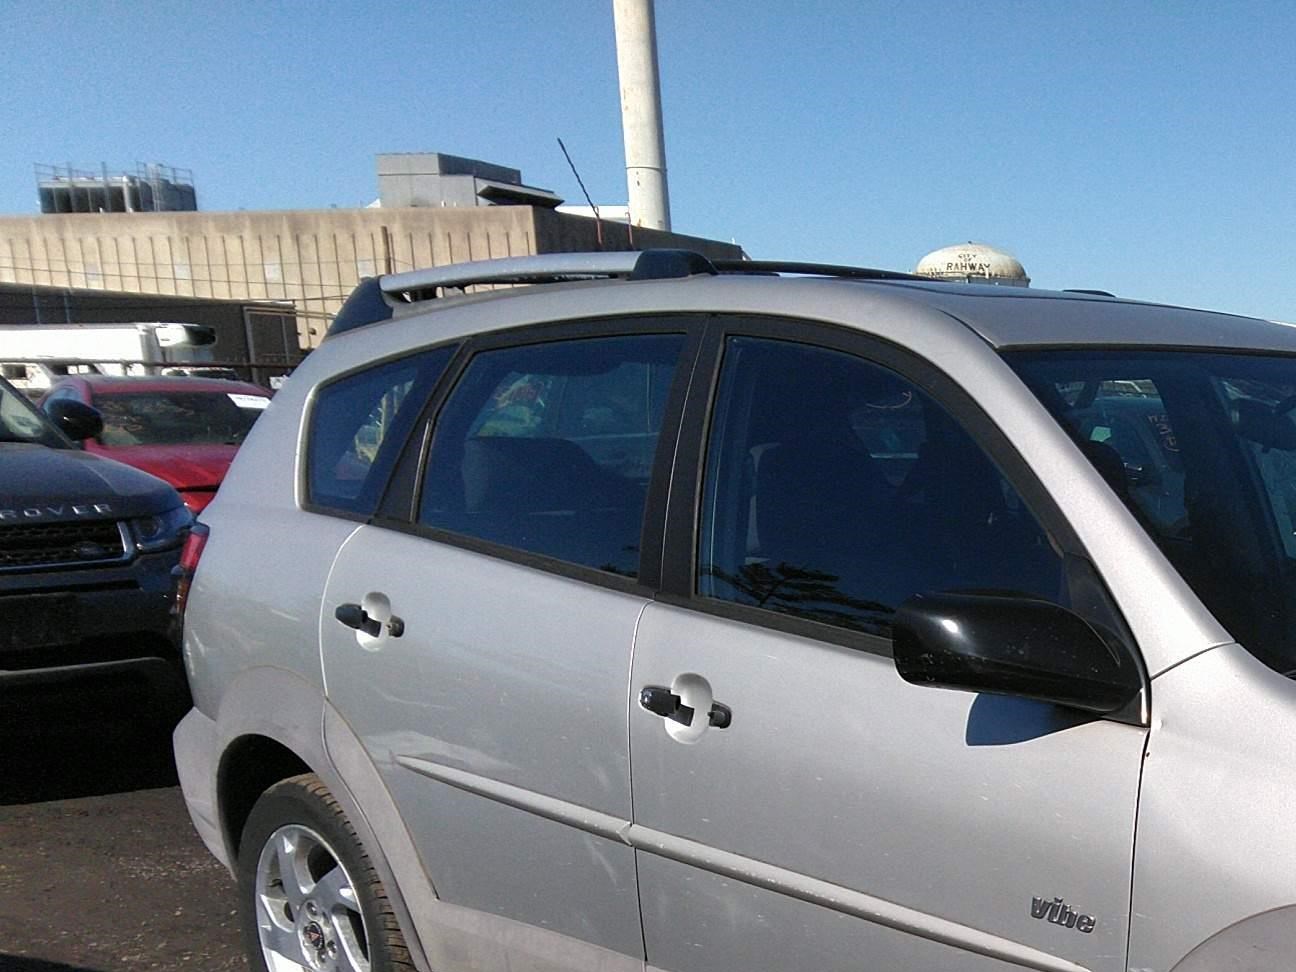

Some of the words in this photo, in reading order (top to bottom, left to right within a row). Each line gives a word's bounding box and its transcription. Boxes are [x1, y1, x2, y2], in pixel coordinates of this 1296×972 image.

[946, 262, 991, 272] RAHWAY
[0, 503, 113, 520] ROVER
[1030, 895, 1097, 934] vibe
